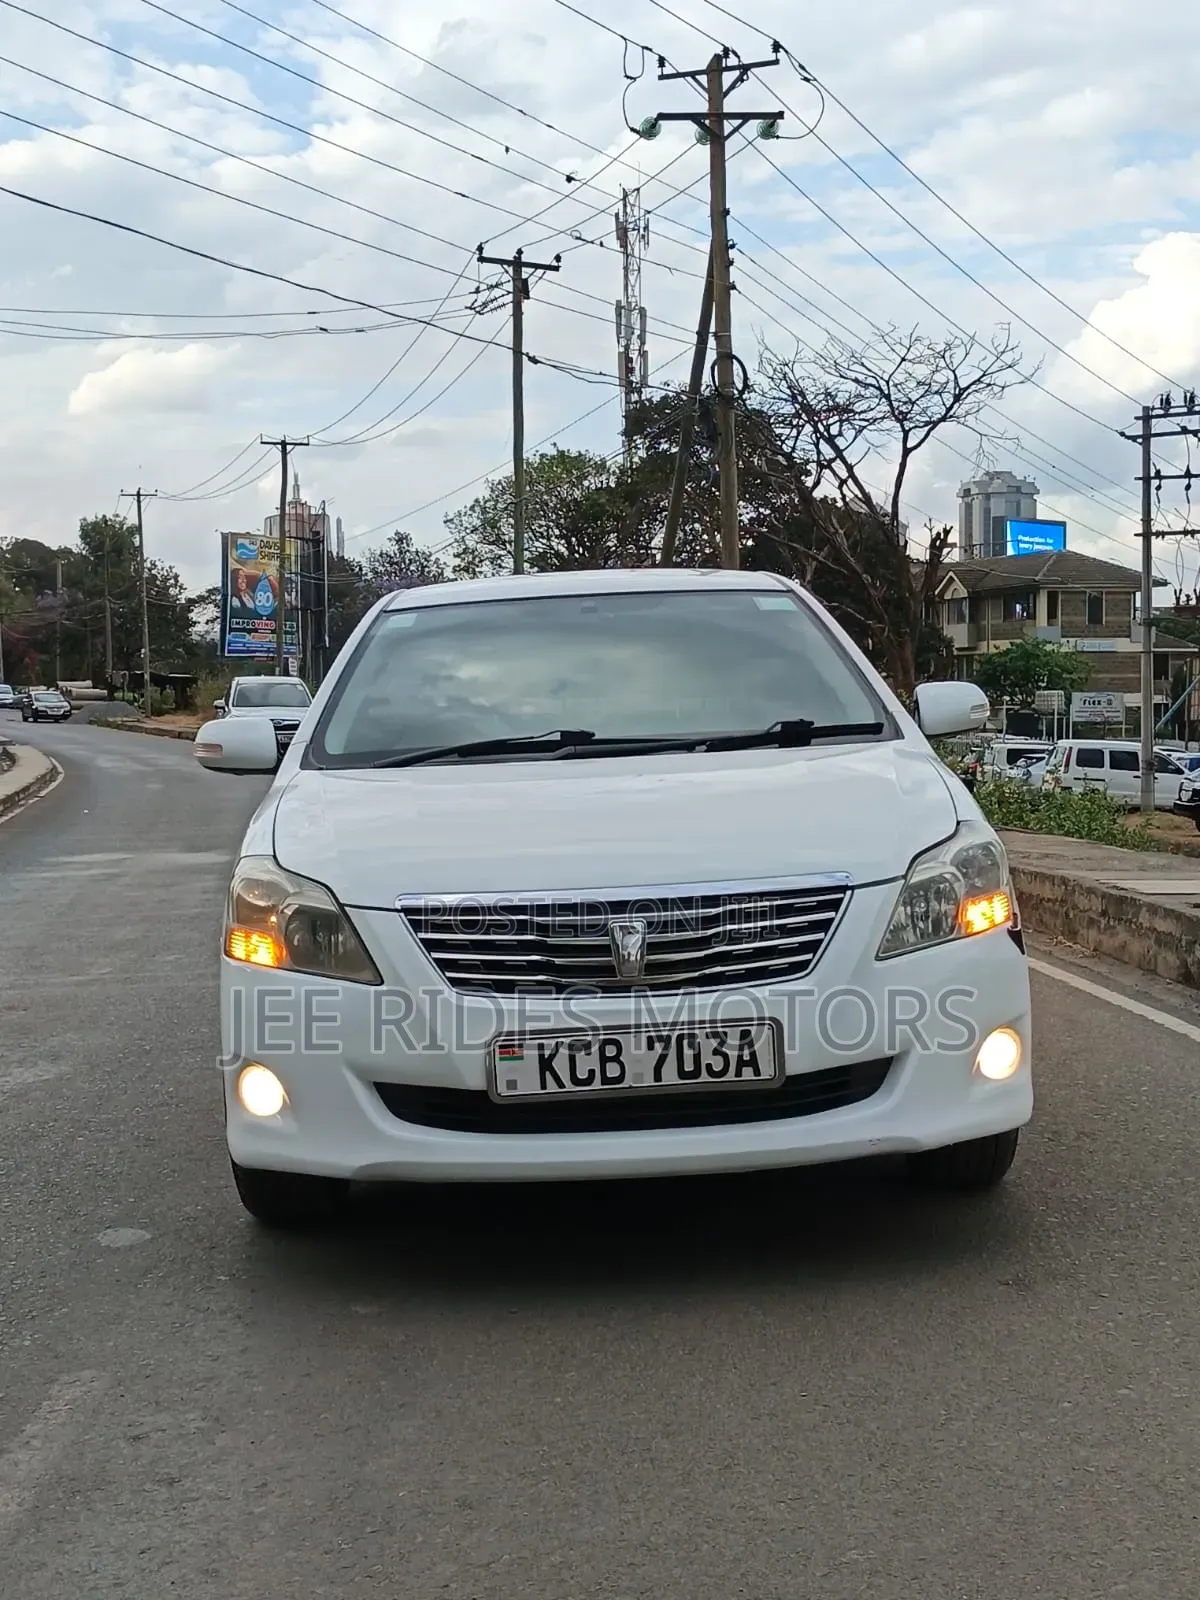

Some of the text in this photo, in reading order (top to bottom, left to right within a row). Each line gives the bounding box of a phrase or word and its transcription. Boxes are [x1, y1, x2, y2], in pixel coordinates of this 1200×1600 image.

[260, 540, 281, 551] DAVIS
[256, 591, 274, 605] 80
[231, 619, 276, 629] IMPROVING
[537, 1027, 762, 1091] KCB 703A
